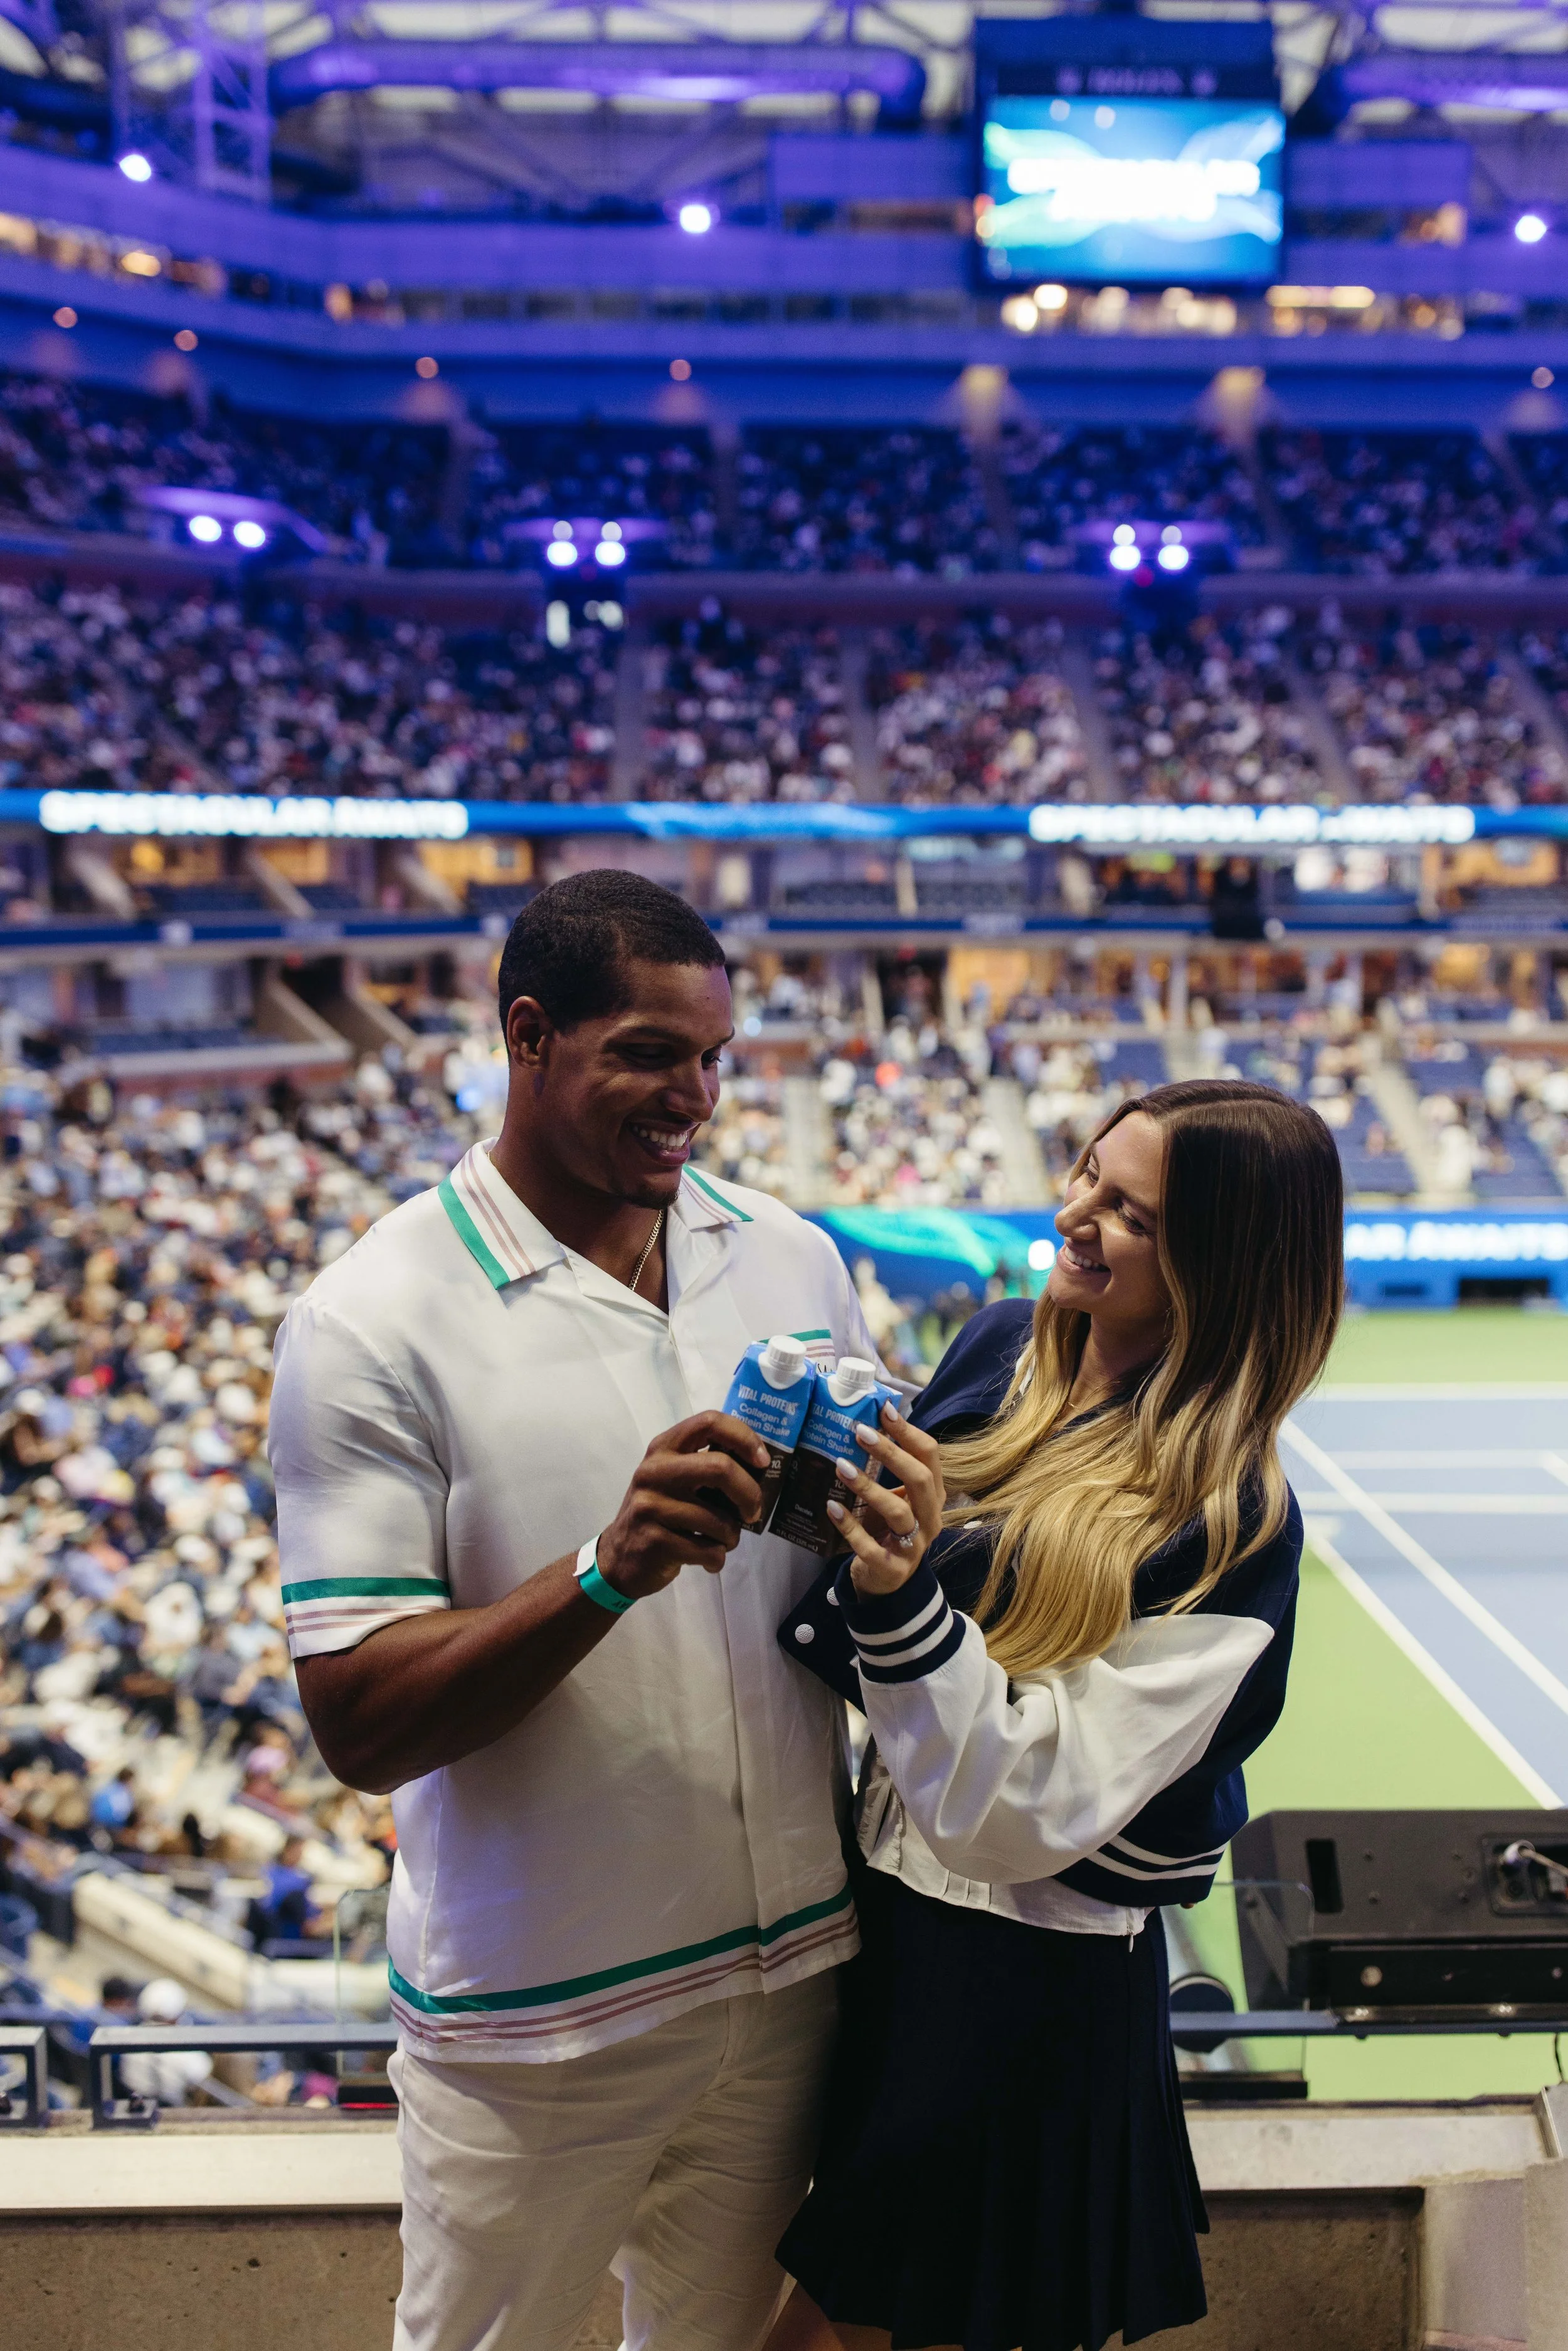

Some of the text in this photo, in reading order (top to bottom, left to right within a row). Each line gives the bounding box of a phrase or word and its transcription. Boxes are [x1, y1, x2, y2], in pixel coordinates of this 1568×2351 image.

[738, 1384, 797, 1416] VITAL PROTEINS
[739, 1403, 788, 1426] Collagen &
[763, 1422, 790, 1437] Shake
[808, 1419, 850, 1444] Collagen &
[827, 1438, 854, 1455] Shake
